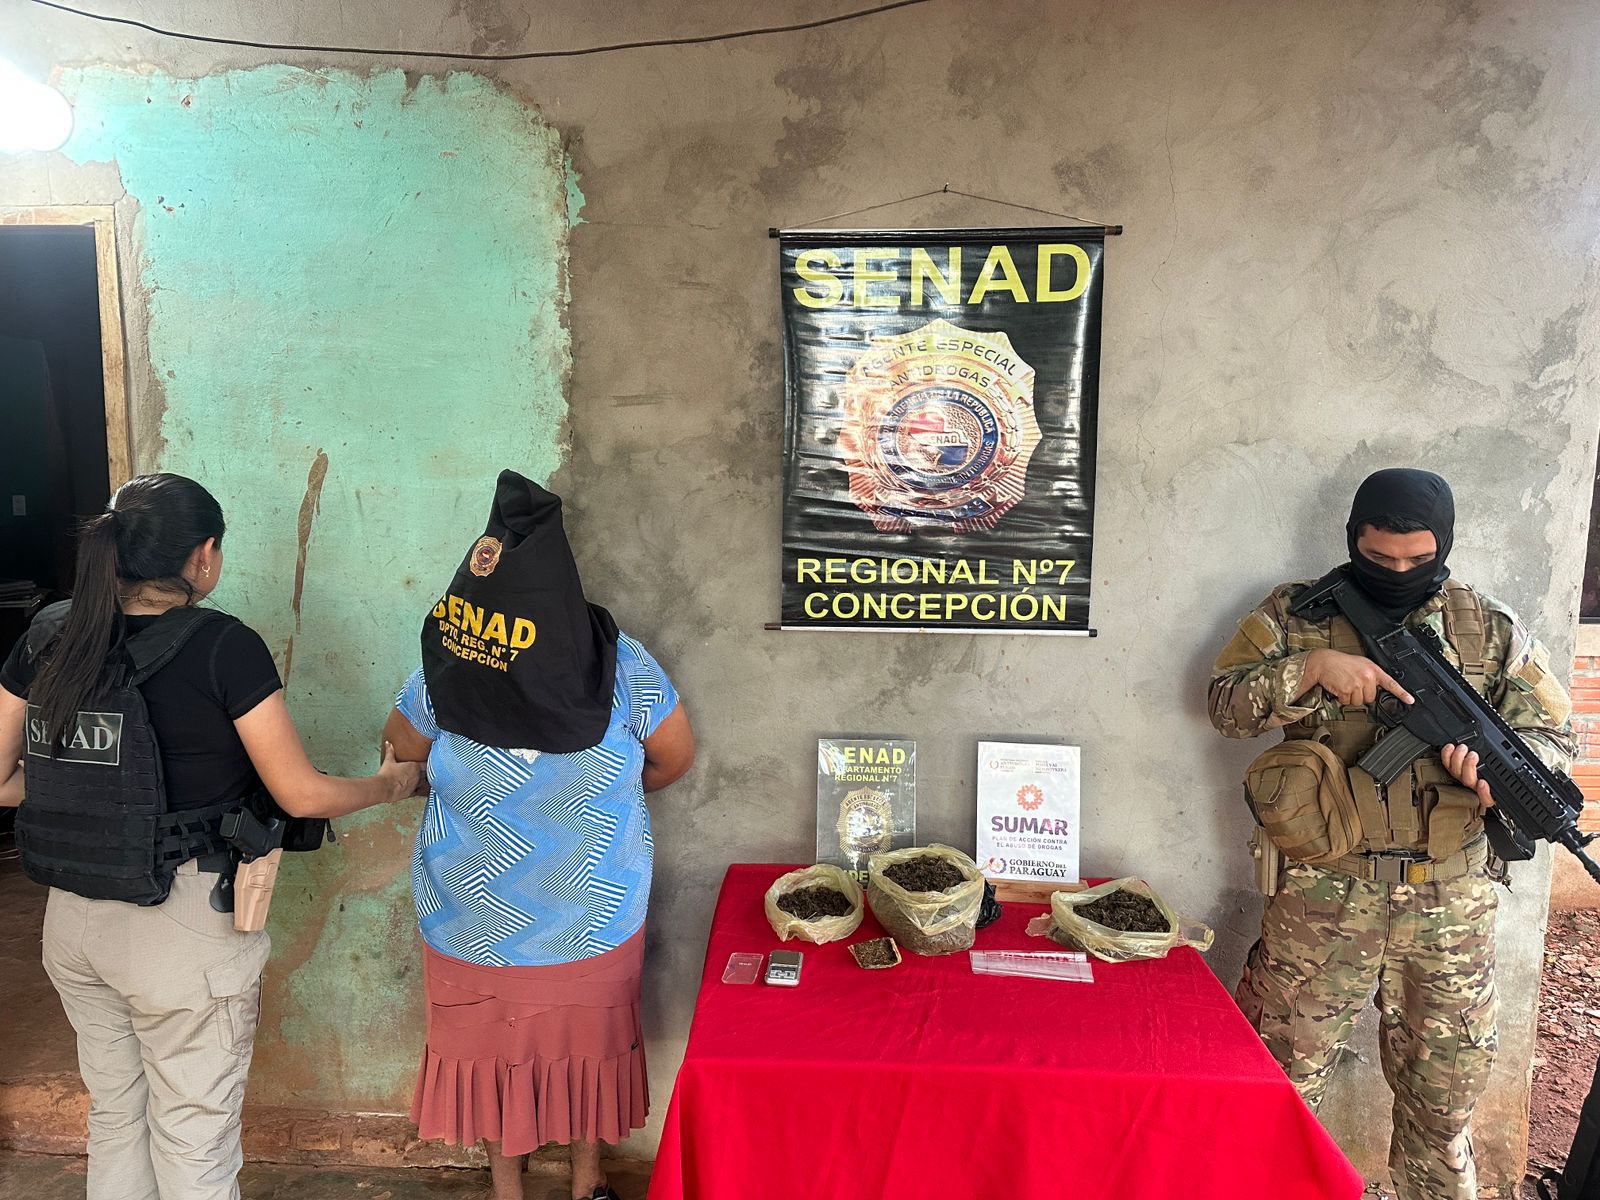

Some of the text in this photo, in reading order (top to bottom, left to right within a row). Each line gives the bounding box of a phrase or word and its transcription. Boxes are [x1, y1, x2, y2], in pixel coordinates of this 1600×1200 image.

[793, 244, 1092, 308] SENAD
[936, 338, 1018, 377] ESPECIAL
[797, 558, 999, 585] REGIONAL
[804, 587, 1067, 621] CONCEPCIÓN
[442, 635, 508, 673] CONCEPCION
[461, 634, 489, 653] REG.
[510, 650, 519, 662] 7
[834, 774, 880, 782] REGIONAL
[991, 815, 1068, 836] SUMAR
[1009, 859, 1055, 868] GOBIERNO
[1010, 866, 1067, 878] PARAGUAY
